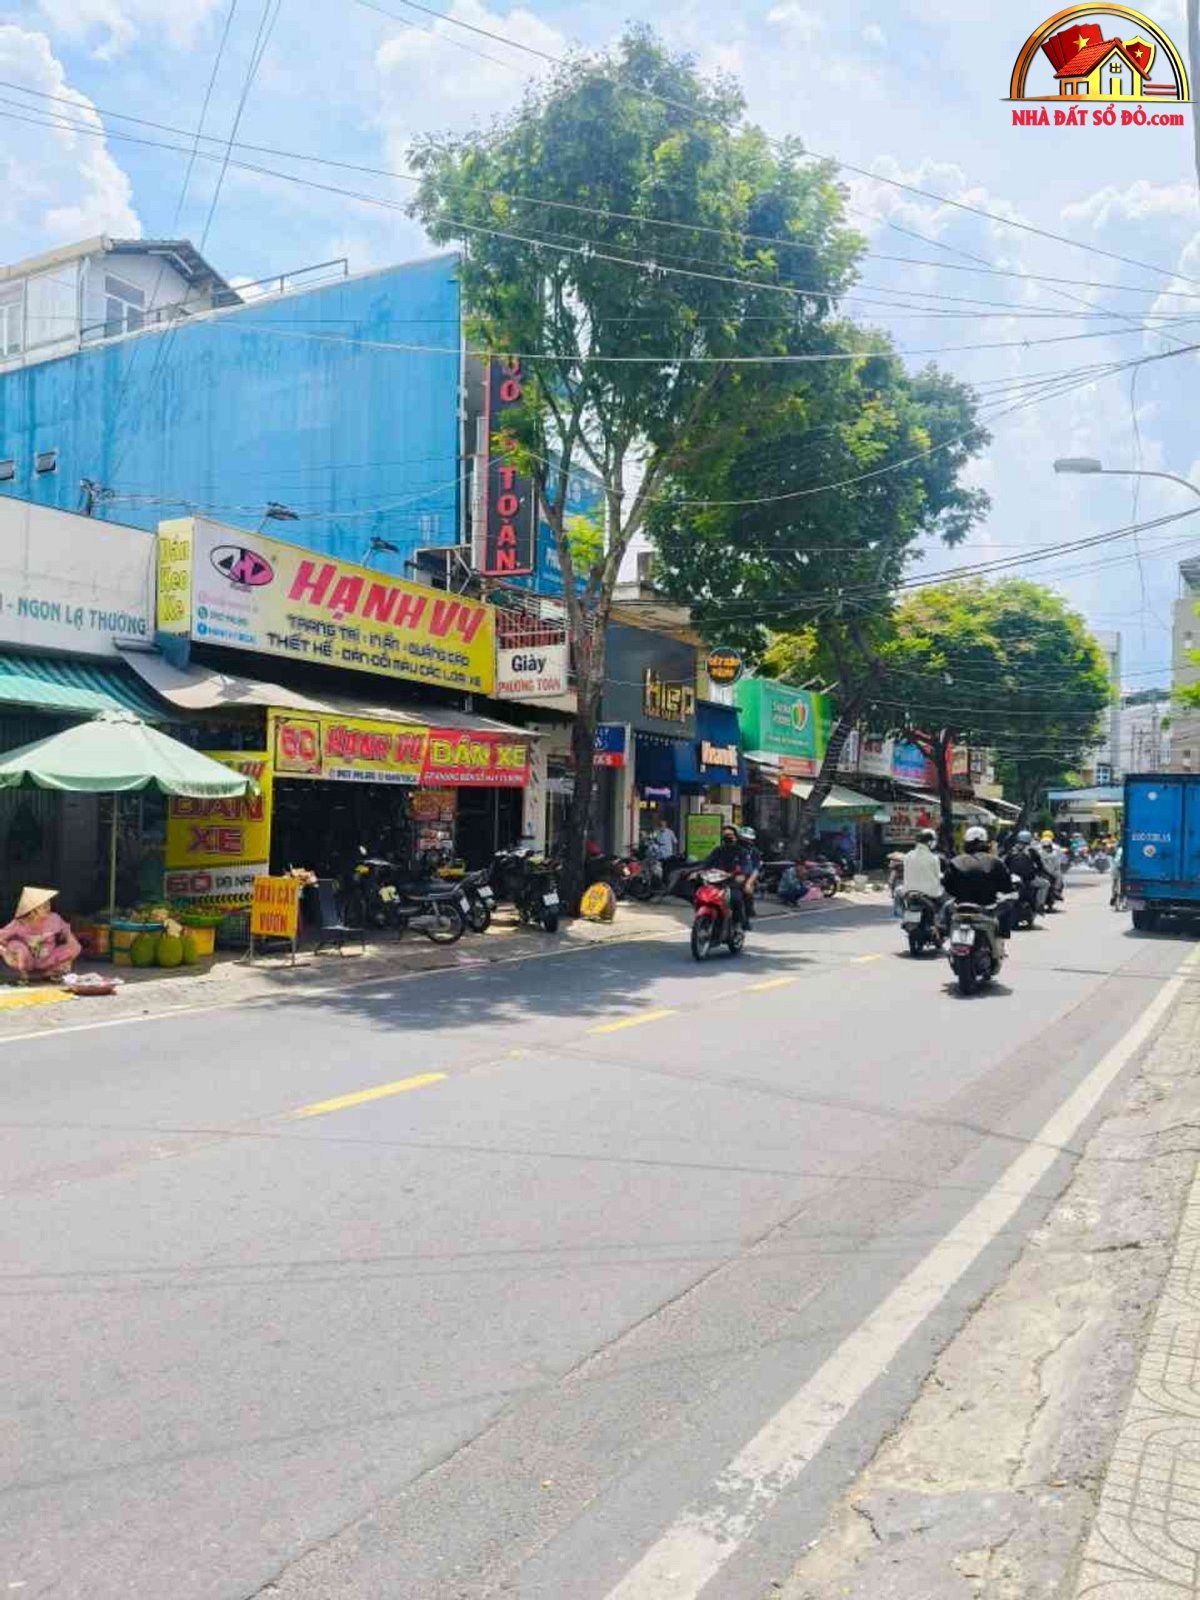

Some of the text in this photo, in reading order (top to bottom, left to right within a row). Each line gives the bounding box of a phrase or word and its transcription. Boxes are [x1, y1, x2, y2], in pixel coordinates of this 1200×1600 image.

[18, 596, 61, 622] NGON
[288, 559, 486, 643] HẠNH VY
[511, 653, 547, 673] Giày
